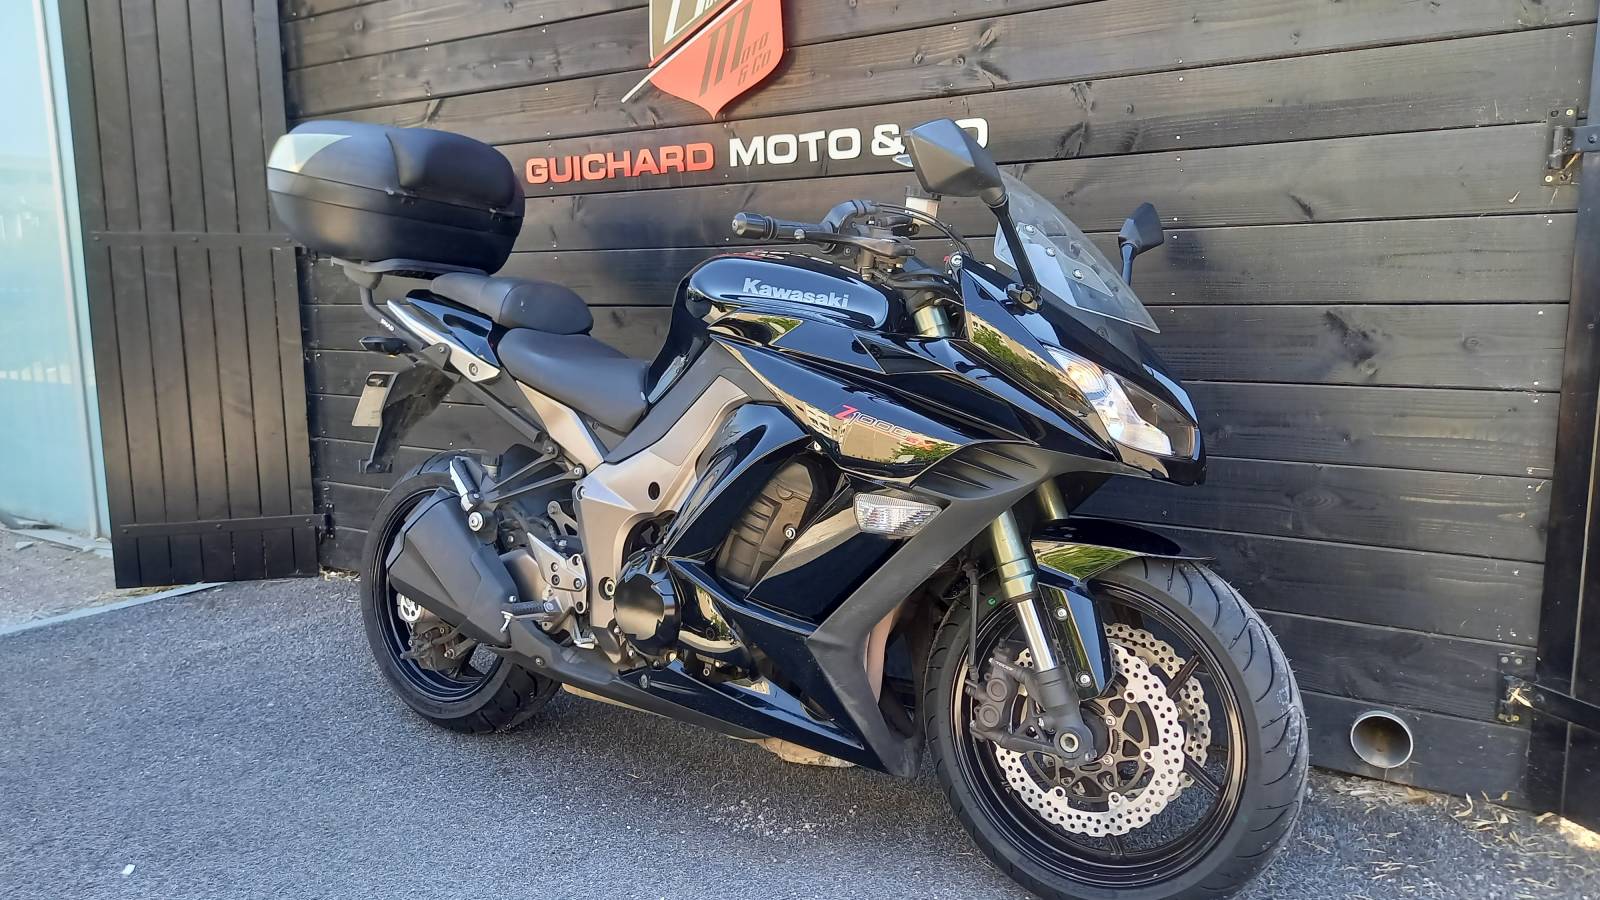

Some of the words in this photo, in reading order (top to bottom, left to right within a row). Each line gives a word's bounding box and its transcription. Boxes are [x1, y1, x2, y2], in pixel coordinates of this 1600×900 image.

[526, 143, 714, 184] GUICHARD
[730, 129, 861, 167] MOTO
[871, 123, 906, 156] &
[743, 277, 849, 310] Kawasaki
